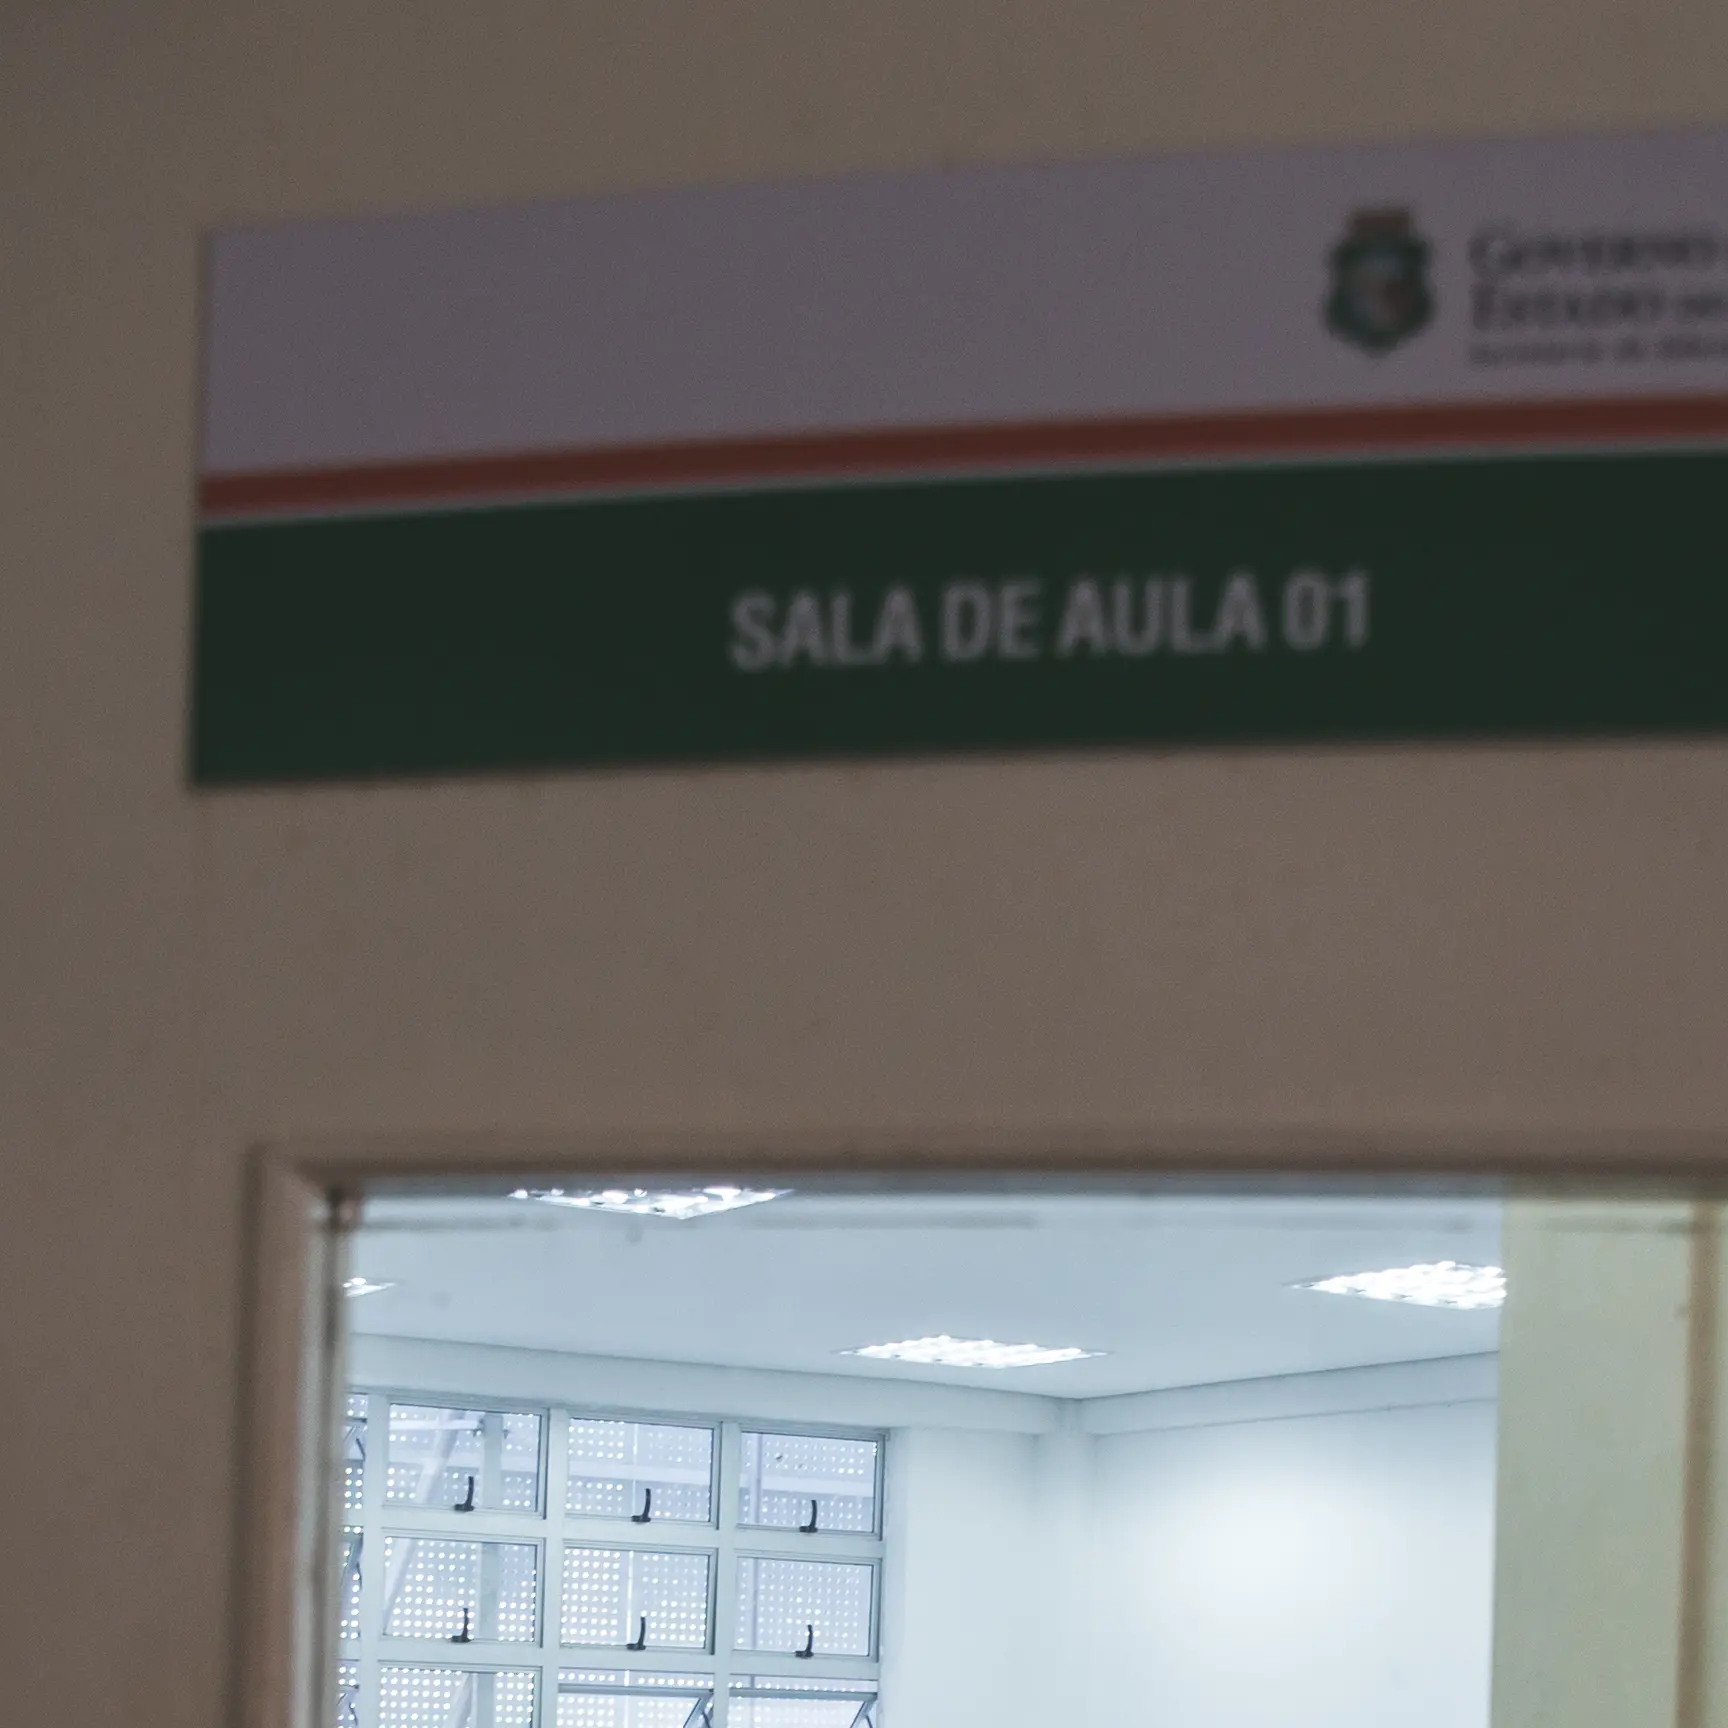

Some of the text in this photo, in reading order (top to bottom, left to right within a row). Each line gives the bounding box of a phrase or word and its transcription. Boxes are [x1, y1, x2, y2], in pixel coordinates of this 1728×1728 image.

[731, 569, 1370, 670] SALA DE AULA 01
